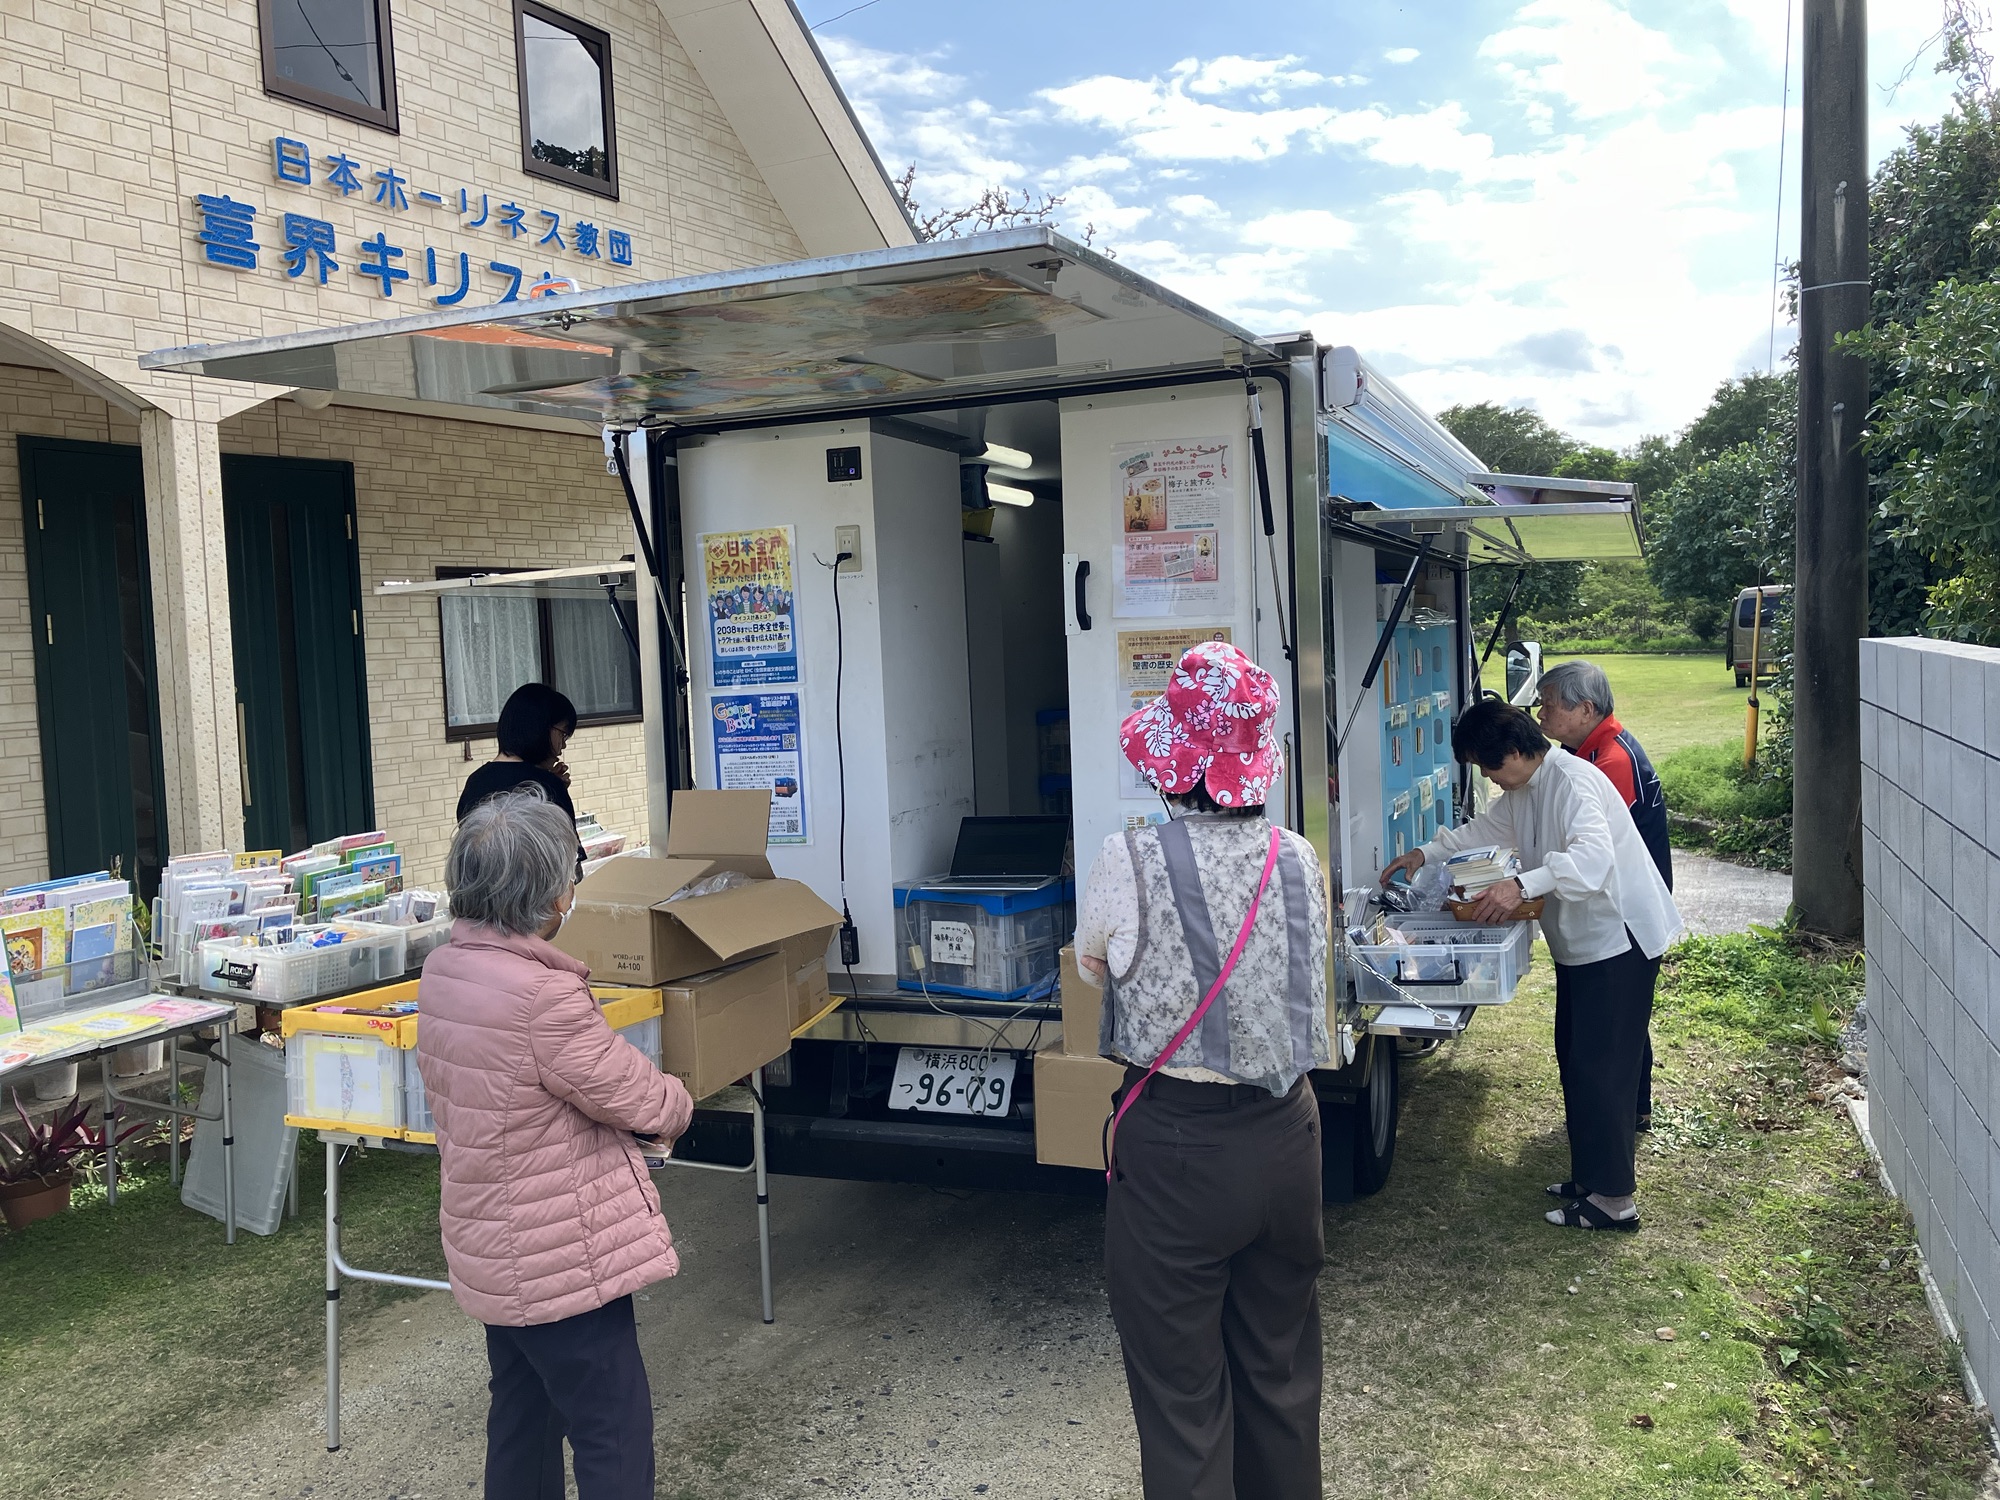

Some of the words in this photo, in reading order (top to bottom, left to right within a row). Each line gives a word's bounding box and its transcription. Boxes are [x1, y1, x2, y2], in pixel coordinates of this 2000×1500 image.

[270, 136, 633, 267] 日本ホーリネス教団
[716, 621, 790, 635] 2038年までに日本全世帯に
[1133, 660, 1174, 670] 聖書の歴史
[617, 961, 641, 971] A4-100
[916, 1073, 1005, 1110] 96-79
